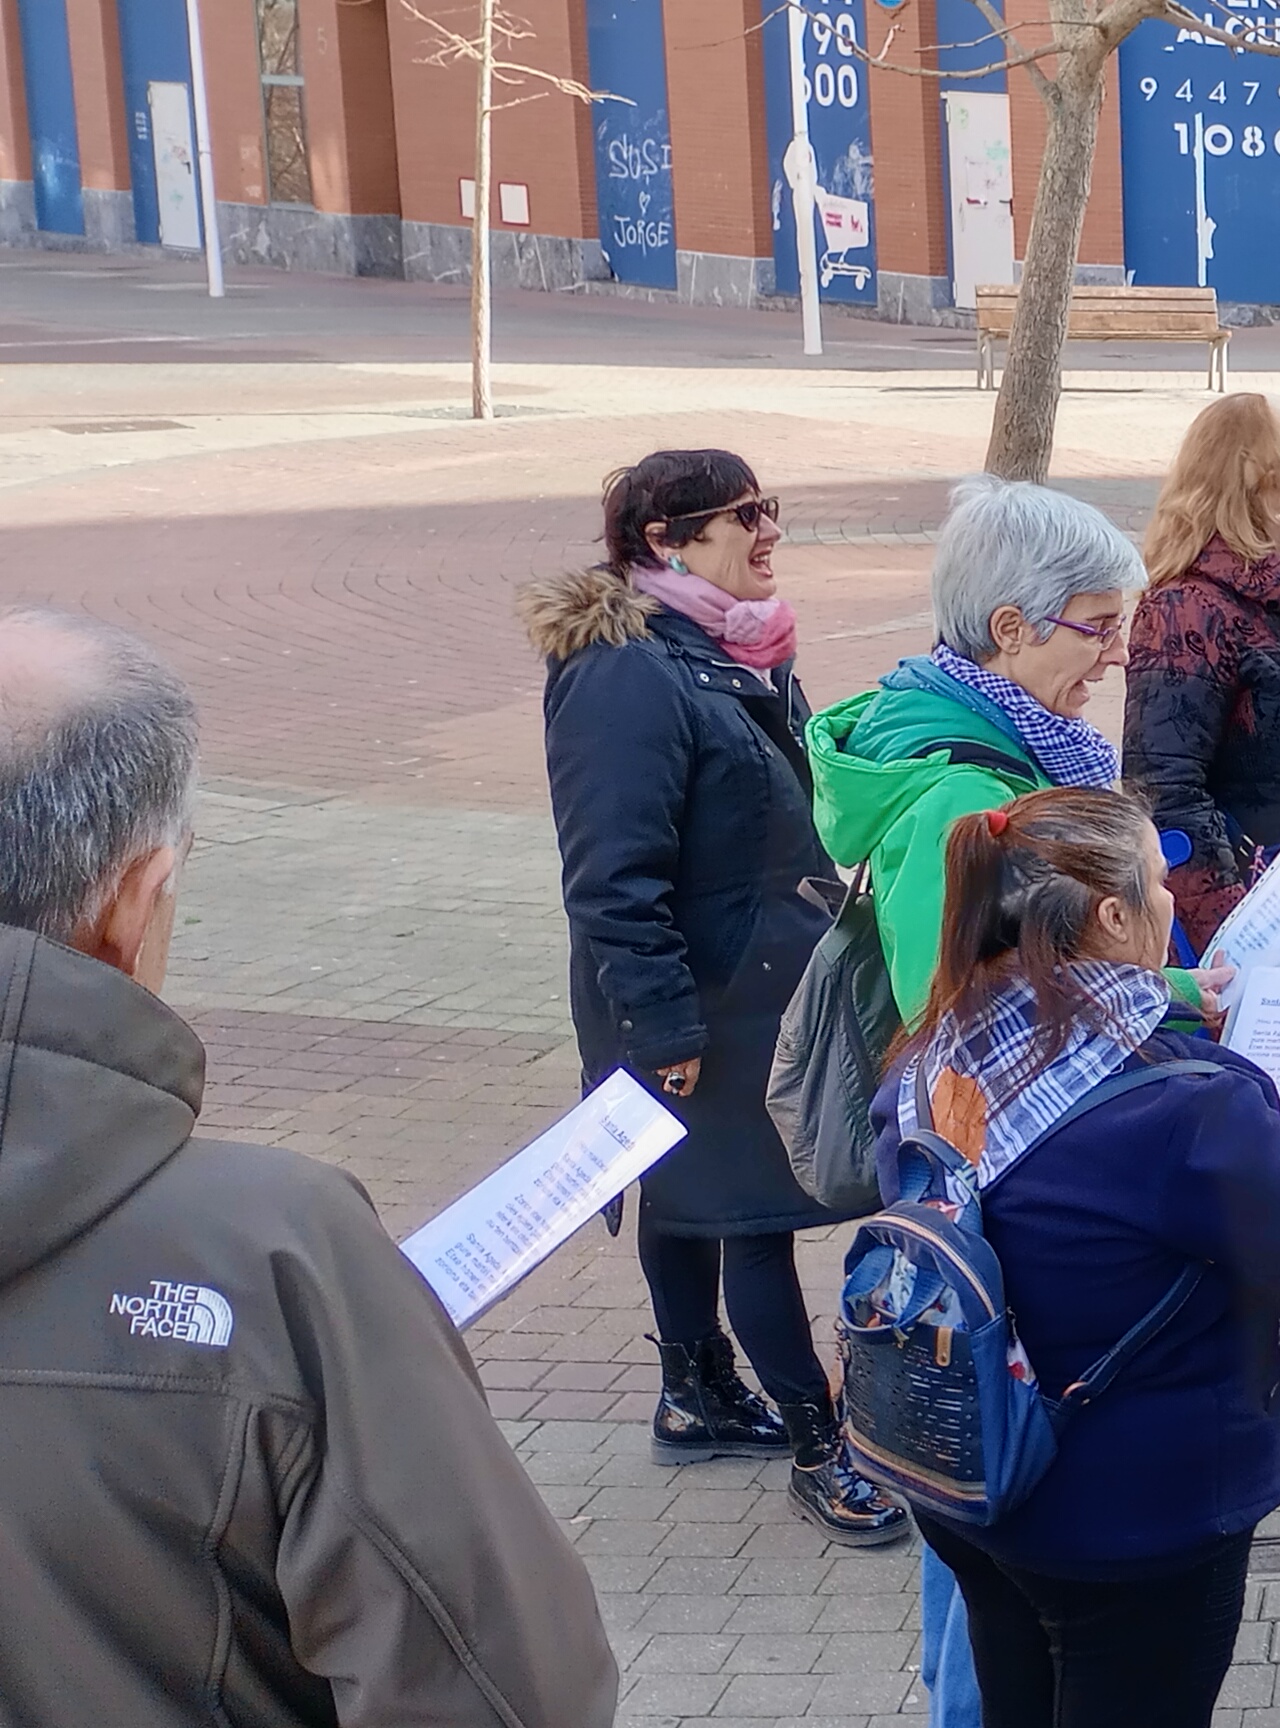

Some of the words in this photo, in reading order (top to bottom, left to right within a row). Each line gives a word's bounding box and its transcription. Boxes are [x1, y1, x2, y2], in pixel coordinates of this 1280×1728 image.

[613, 215, 671, 250] JORGE
[149, 1281, 199, 1304] THE
[109, 1294, 193, 1323] NORTH
[130, 1315, 190, 1341] FACE
